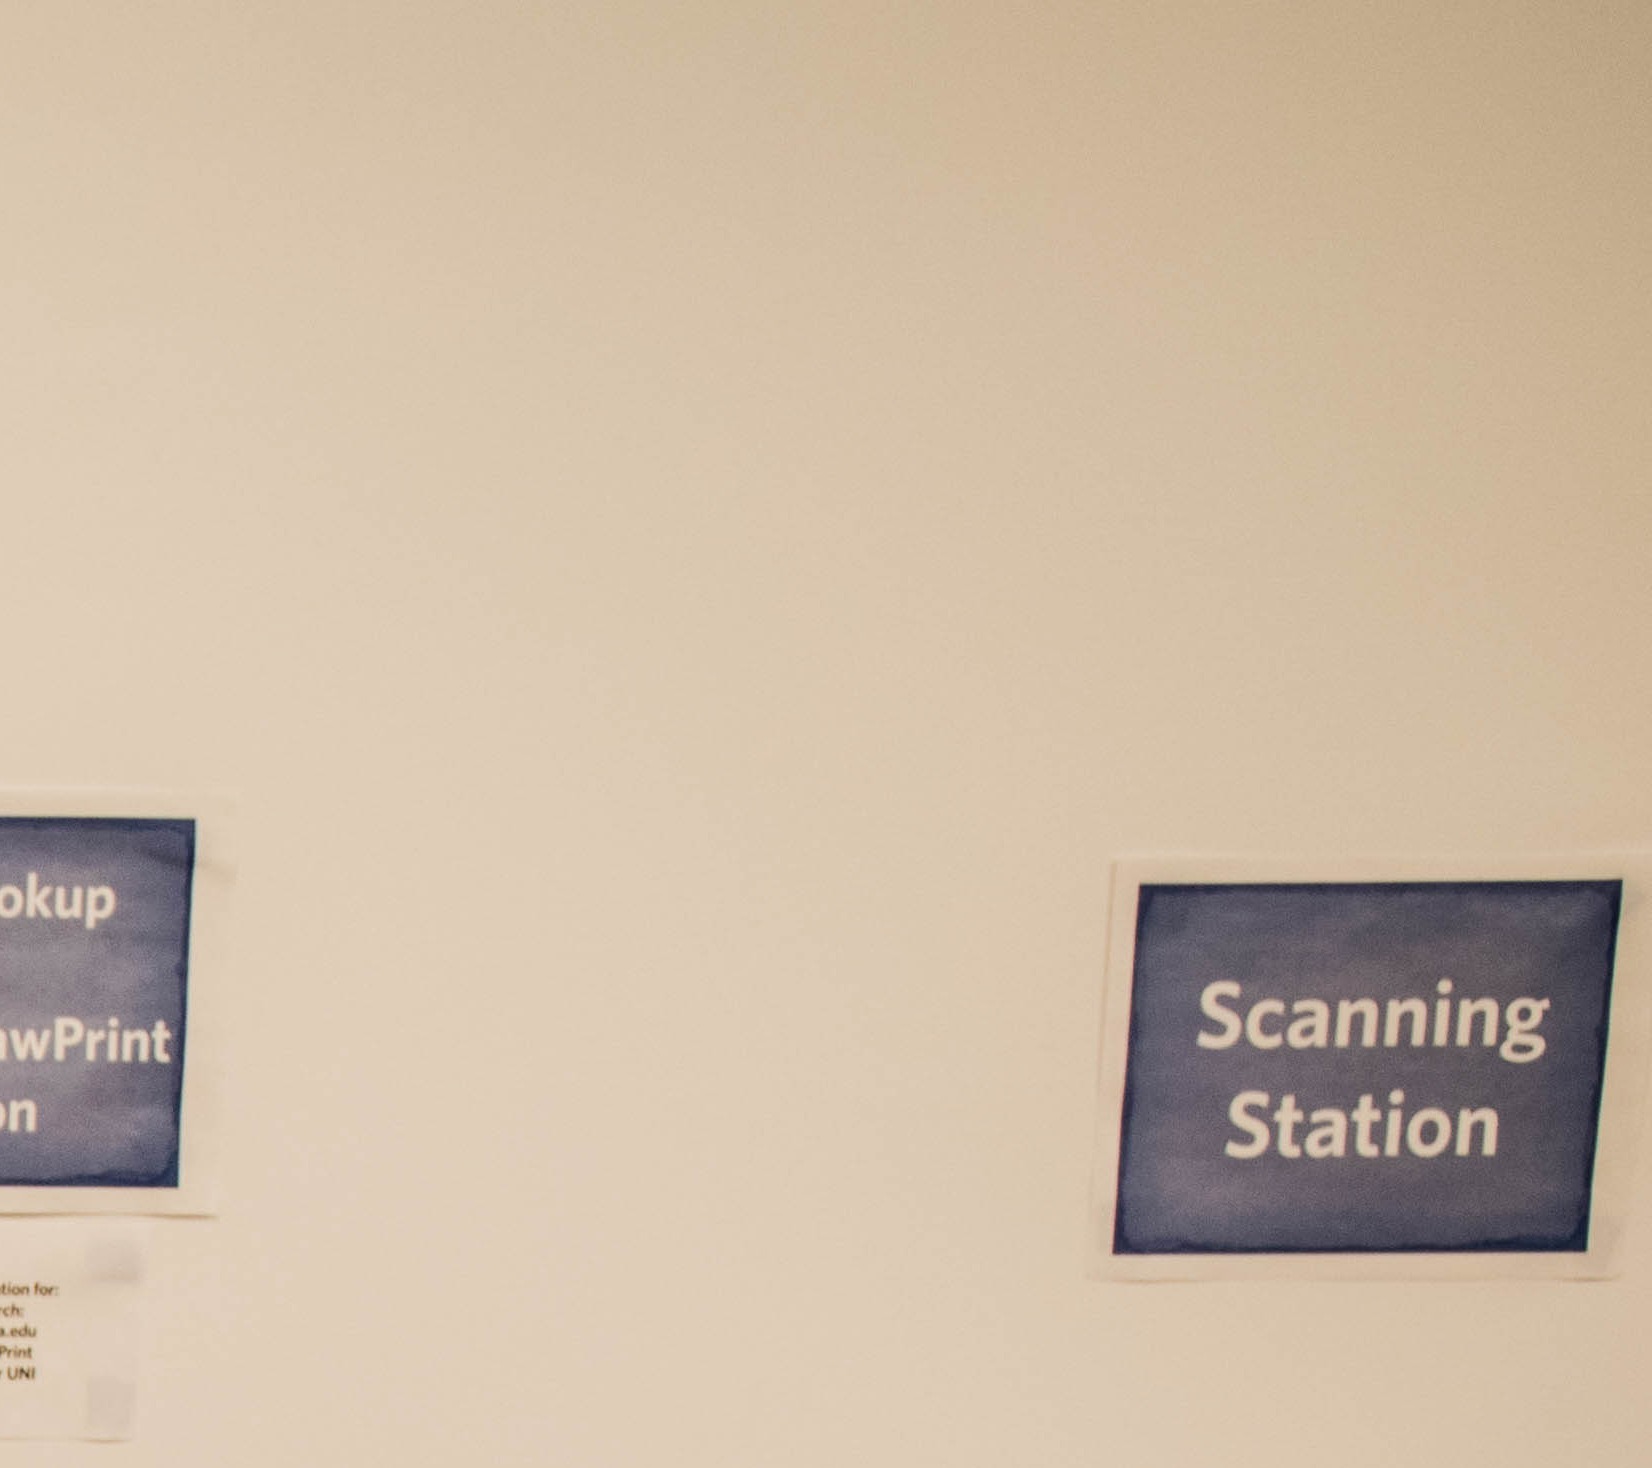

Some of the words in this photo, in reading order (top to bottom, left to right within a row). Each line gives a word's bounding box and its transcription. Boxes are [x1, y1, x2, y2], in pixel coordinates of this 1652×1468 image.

[1196, 978, 1551, 1064] Scanning
[1224, 1089, 1499, 1159] Station
[33, 1281, 59, 1297] for:
[6, 1365, 36, 1381] UNI
